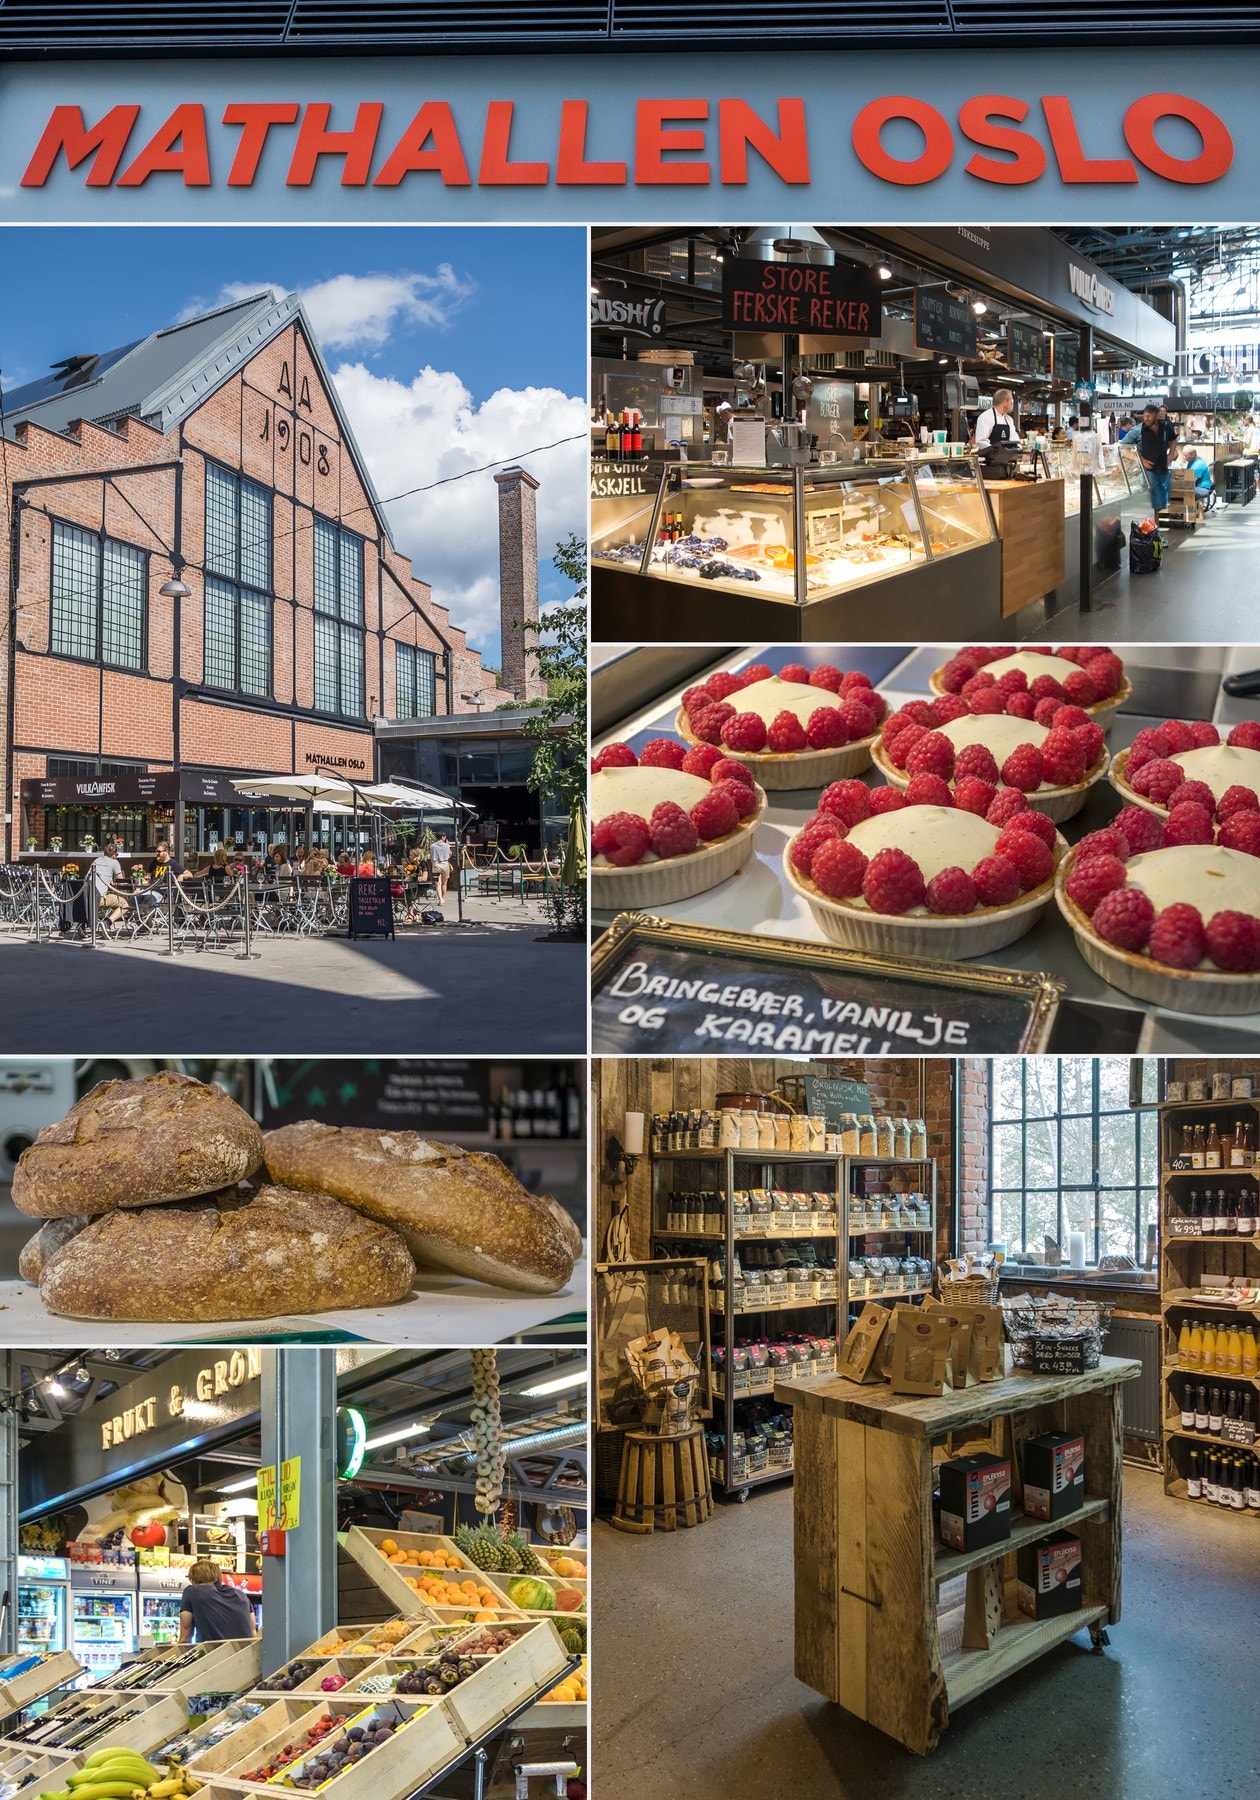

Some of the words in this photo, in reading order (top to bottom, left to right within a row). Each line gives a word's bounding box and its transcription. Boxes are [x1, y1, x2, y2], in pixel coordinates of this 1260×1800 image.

[19, 98, 811, 187] MATHALLEN
[851, 92, 1234, 185] OSLO
[762, 265, 831, 295] STORE
[733, 290, 799, 326] FERSKE
[810, 299, 870, 332] REKER
[1184, 400, 1201, 409] VIA
[259, 408, 330, 477] 1908
[305, 753, 347, 767] MATHALLEN
[348, 759, 365, 770] OSLO
[76, 781, 115, 794] VULKANFISK
[358, 883, 377, 896] REKE
[618, 1004, 666, 1030] OG
[101, 1396, 157, 1451] FRUKT
[169, 1385, 185, 1417] &
